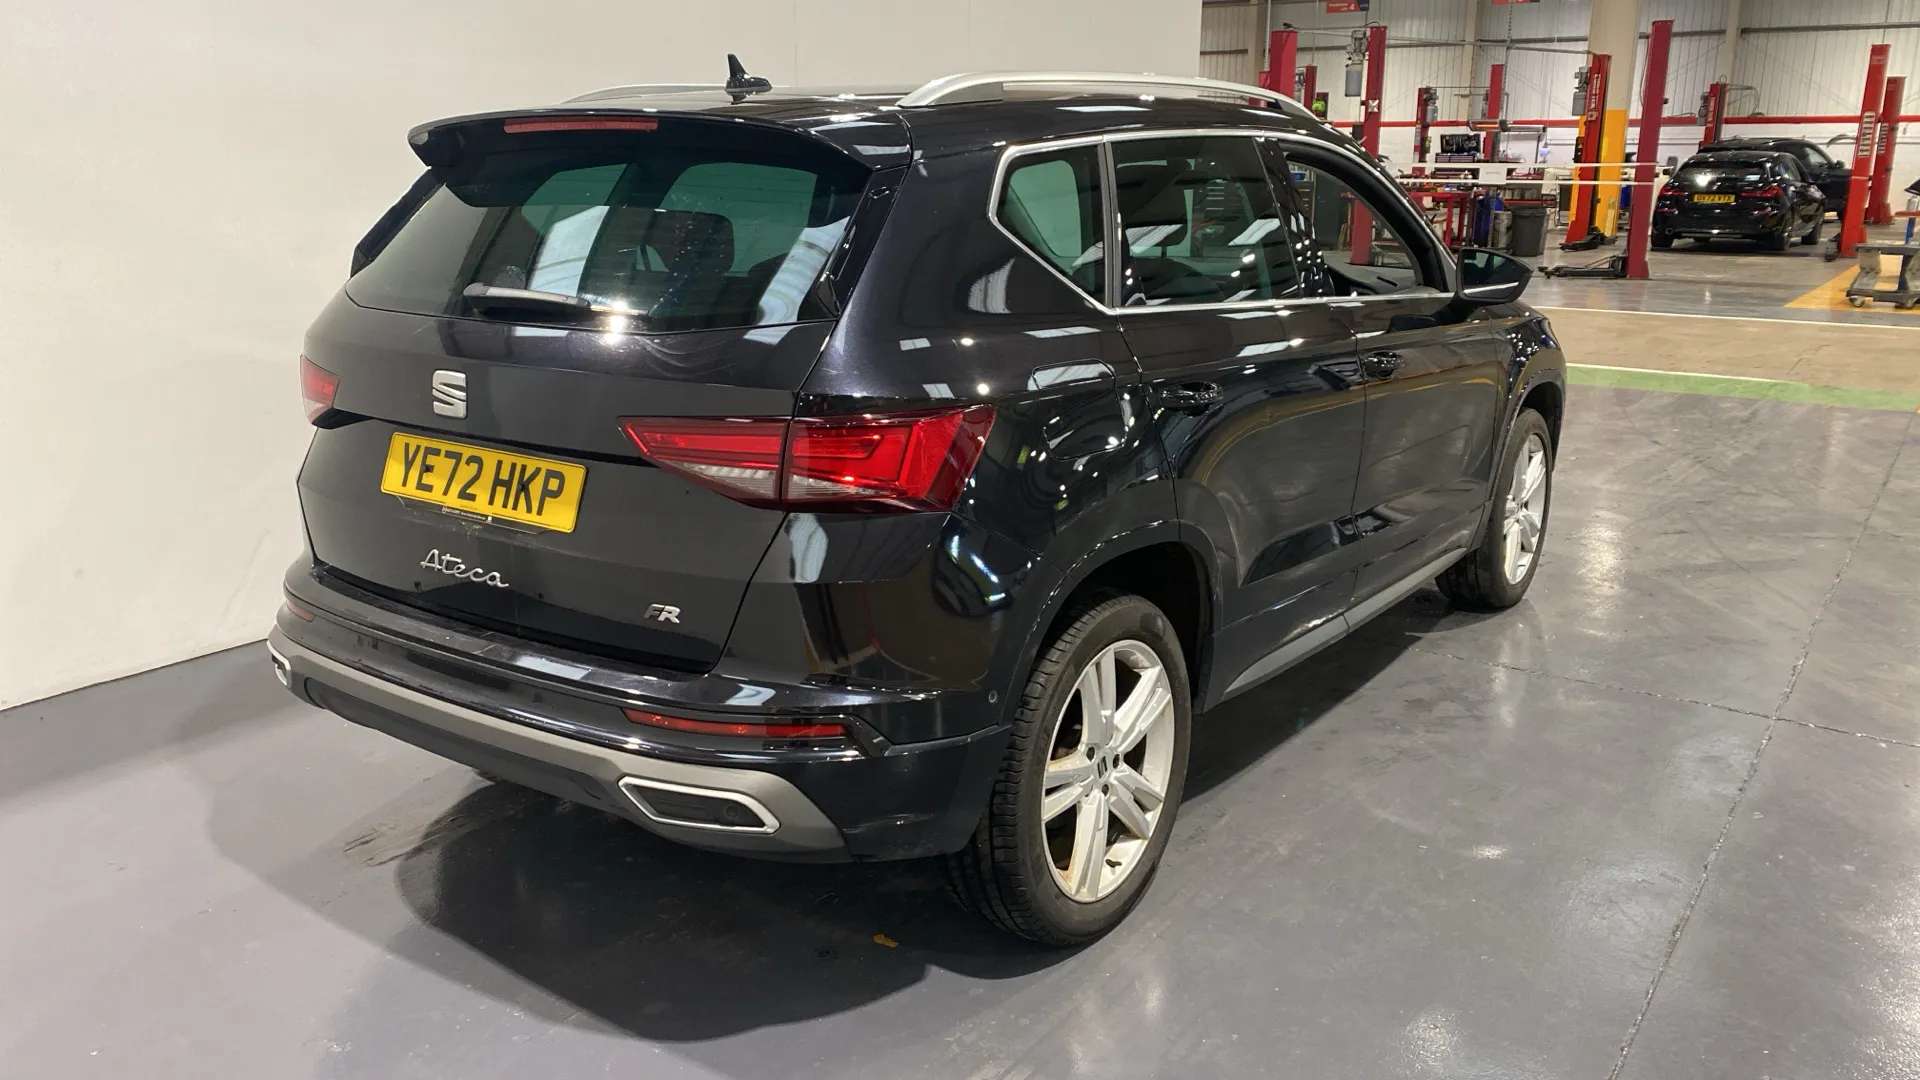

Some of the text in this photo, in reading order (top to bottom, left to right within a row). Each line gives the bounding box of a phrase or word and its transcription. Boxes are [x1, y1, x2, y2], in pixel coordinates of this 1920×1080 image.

[401, 442, 566, 517] YE72 HKP
[420, 548, 510, 588] Ateca
[644, 603, 681, 624] FR
